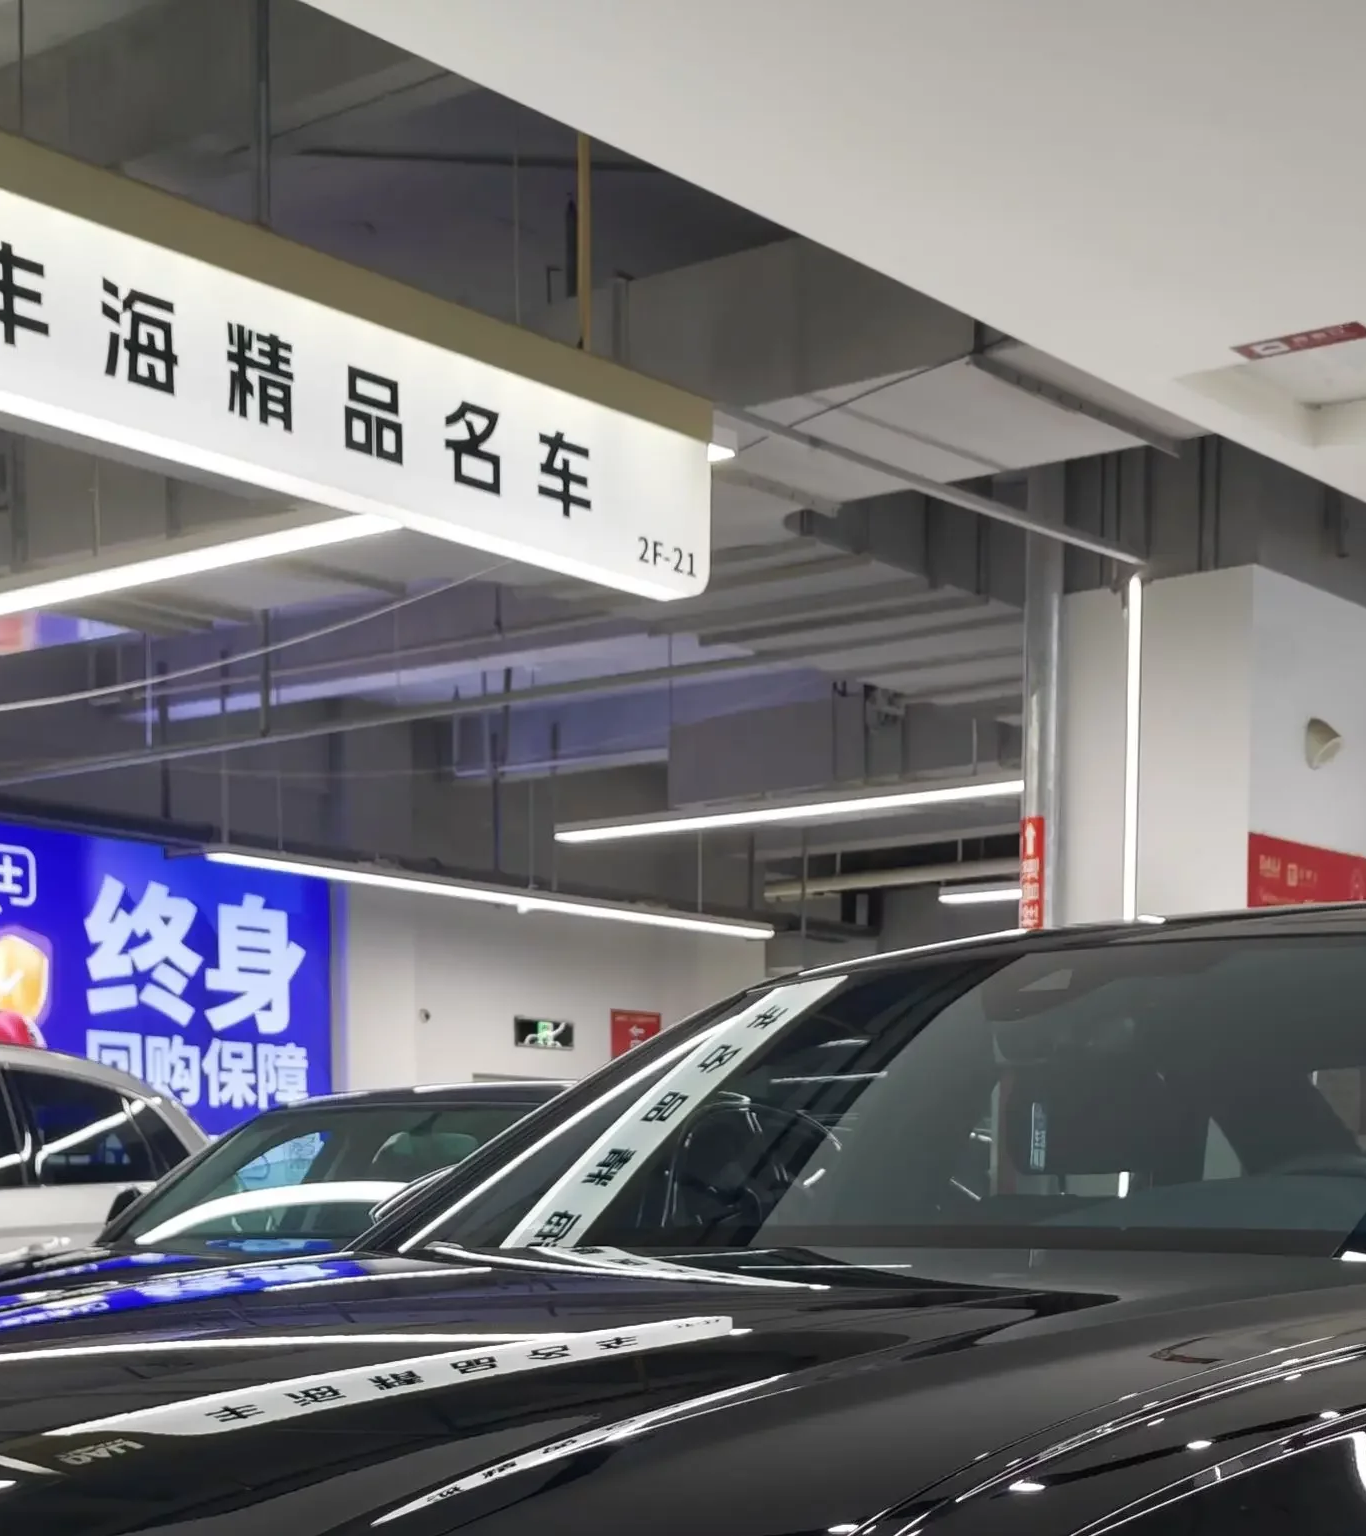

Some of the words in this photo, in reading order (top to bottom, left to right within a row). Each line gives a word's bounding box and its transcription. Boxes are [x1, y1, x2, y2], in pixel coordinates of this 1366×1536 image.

[636, 534, 698, 578] 2F-21
[84, 873, 306, 1034] 终身
[86, 1028, 308, 1109] 回购保障
